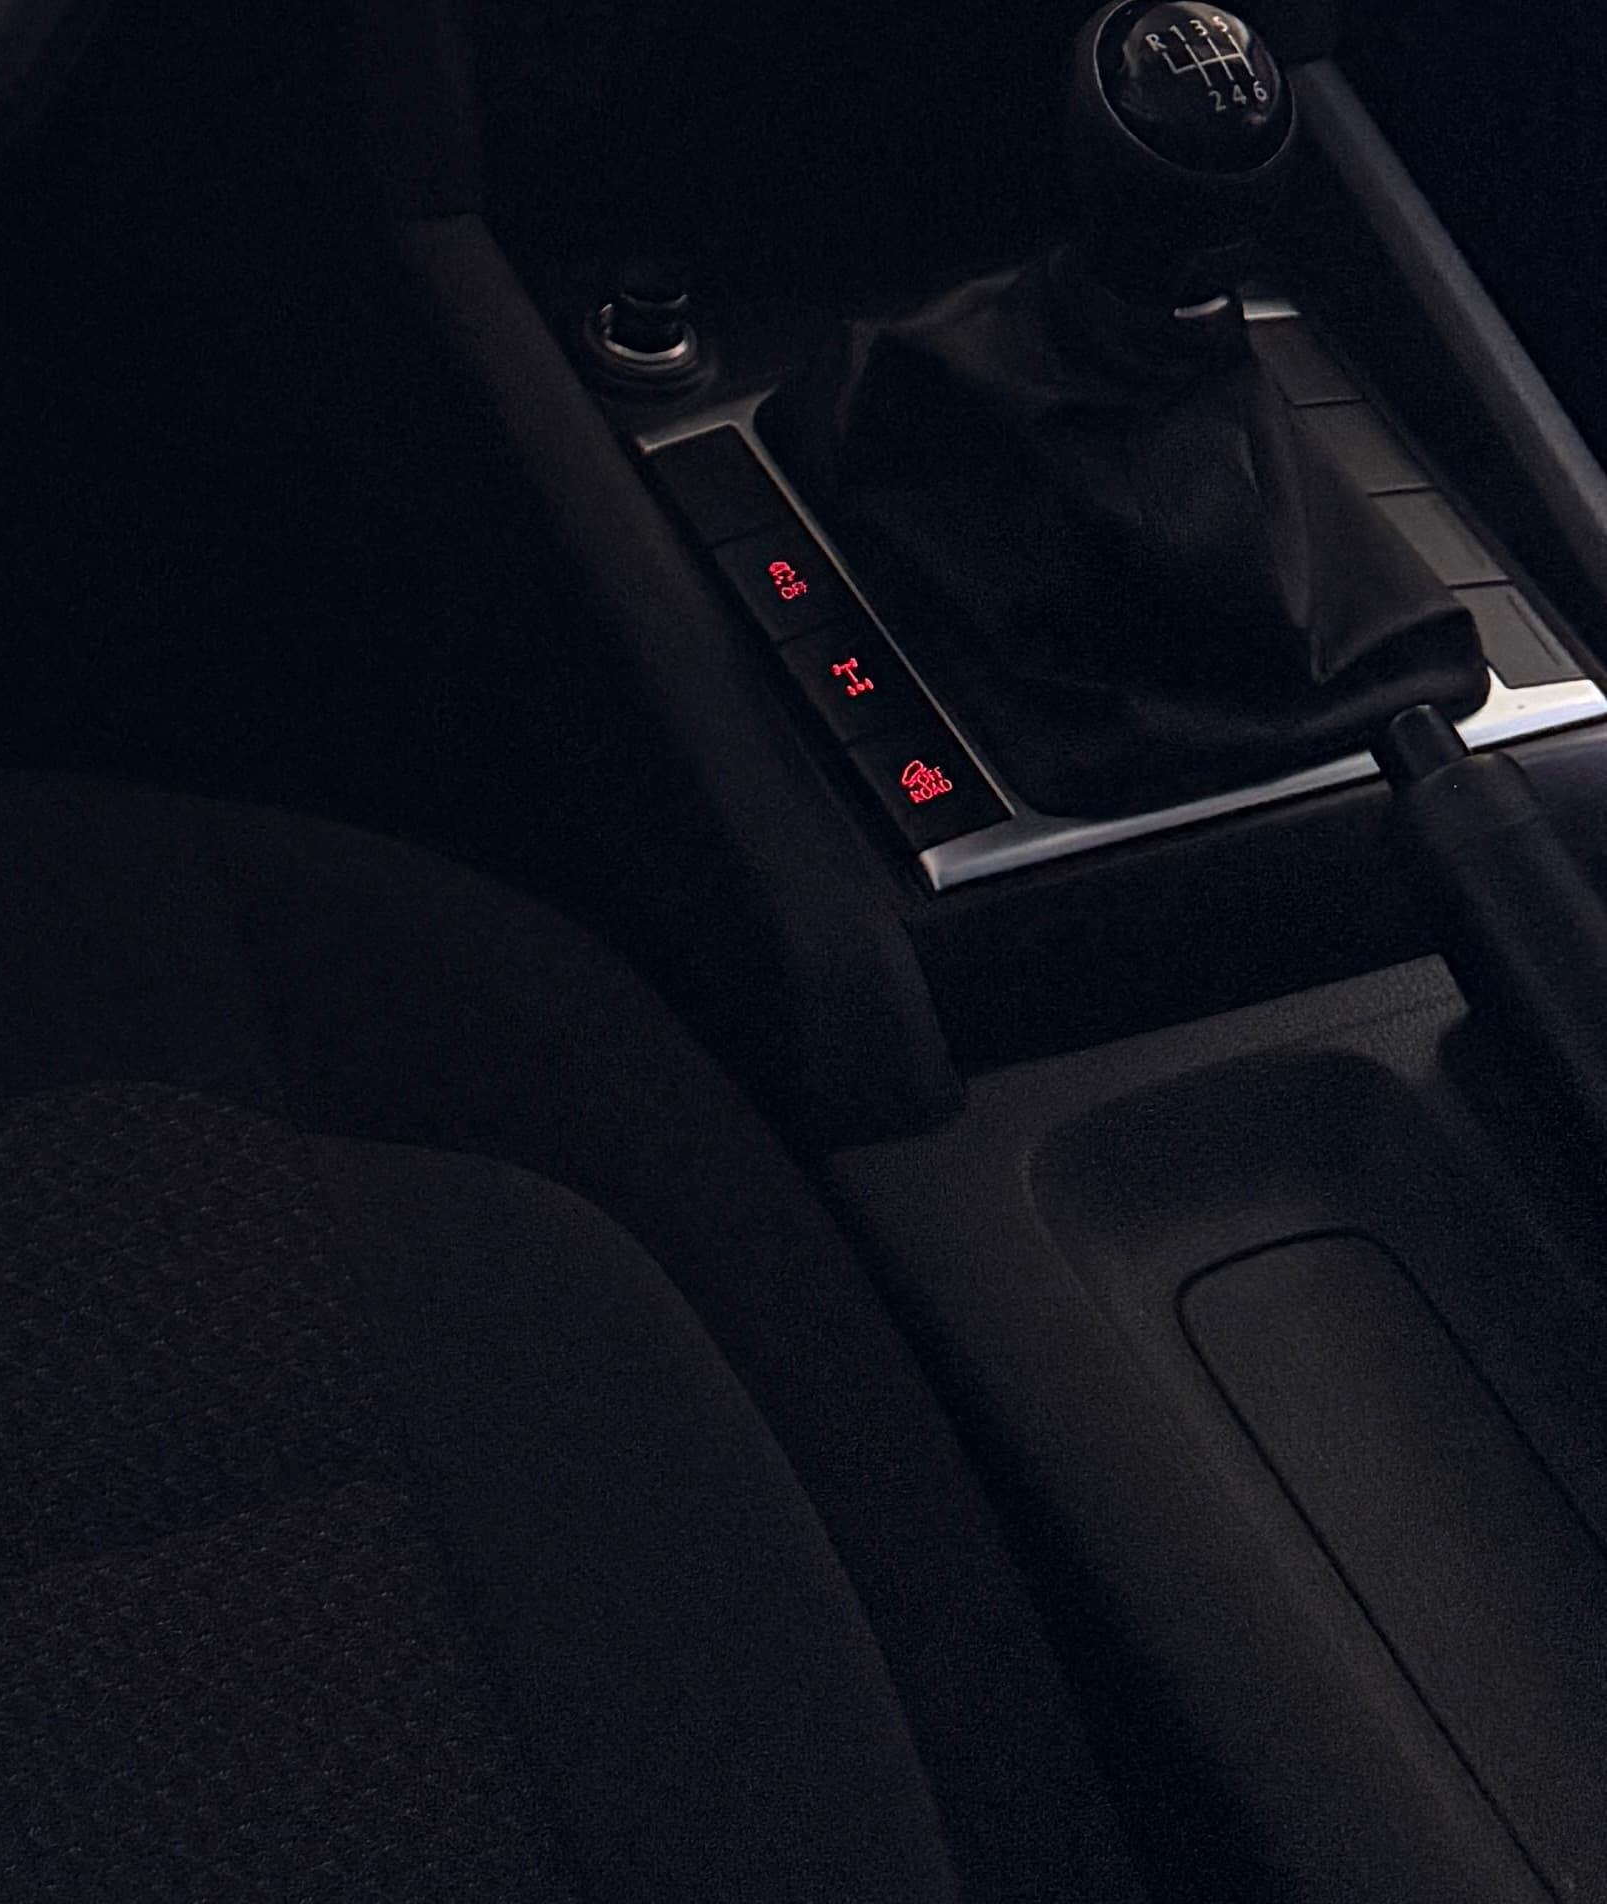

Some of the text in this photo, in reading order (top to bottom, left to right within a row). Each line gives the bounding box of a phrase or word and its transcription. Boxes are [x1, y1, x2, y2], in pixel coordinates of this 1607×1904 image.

[1146, 15, 1228, 52] R 1 3 5
[1209, 80, 1268, 112] 2 4 6
